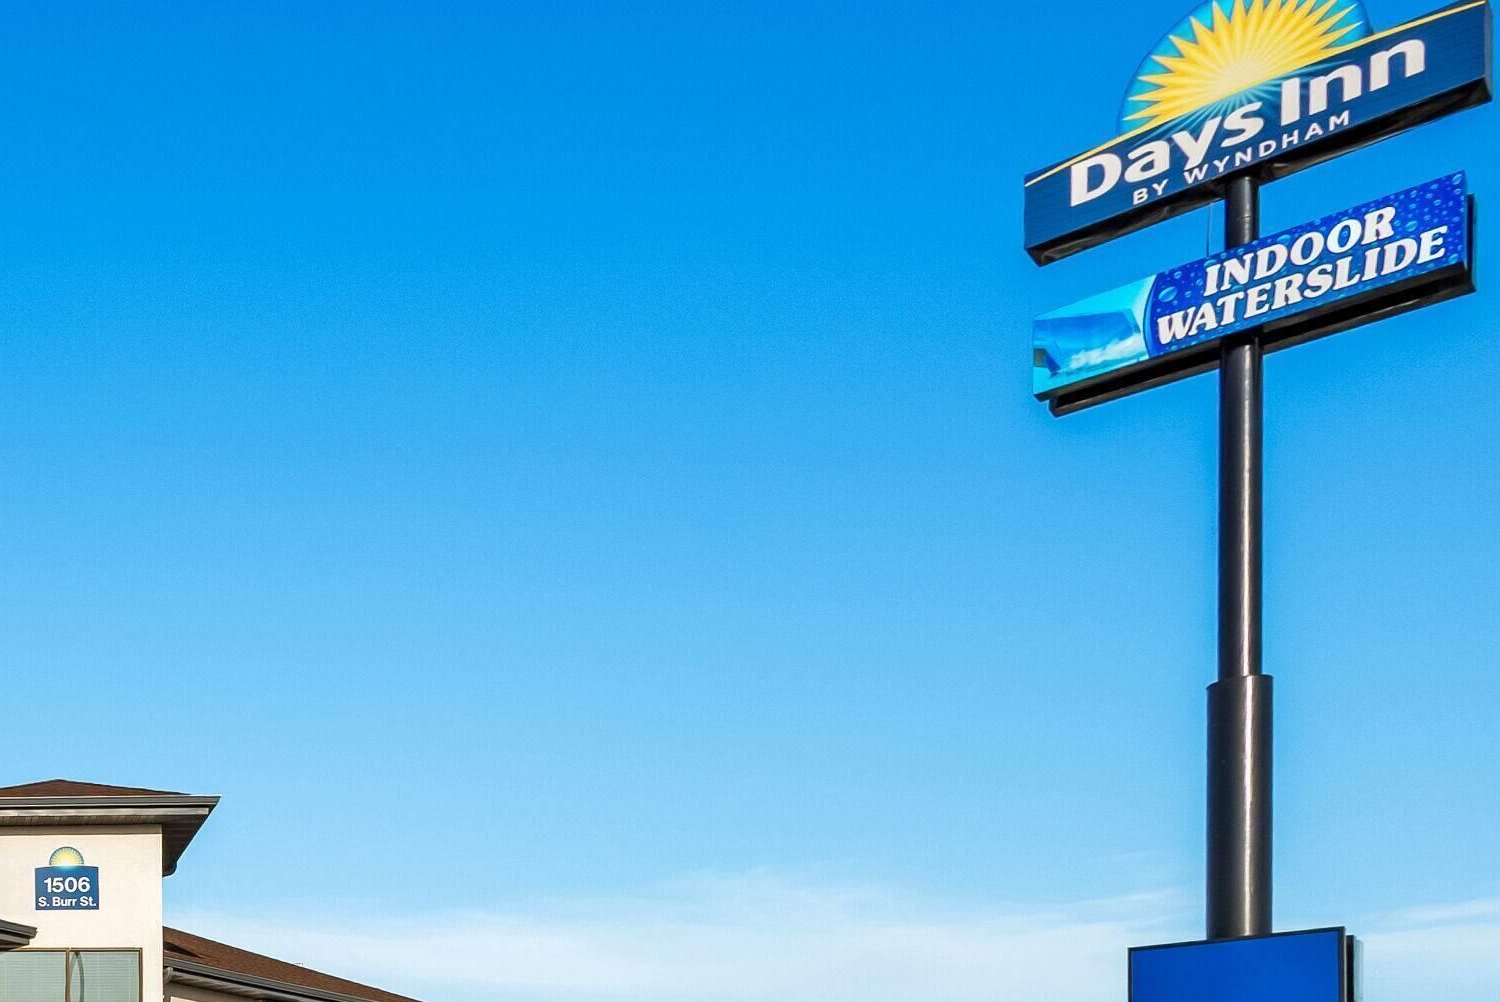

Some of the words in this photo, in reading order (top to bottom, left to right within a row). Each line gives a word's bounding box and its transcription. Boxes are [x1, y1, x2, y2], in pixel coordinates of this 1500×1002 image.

[1070, 101, 1263, 207] Days
[1280, 37, 1426, 122] Inn
[1132, 178, 1170, 206] BY
[1183, 109, 1351, 185] WYNDHAM
[1156, 225, 1449, 346] WATERSLIDE
[1202, 206, 1397, 297] INDOOR
[38, 896, 50, 907] S.
[52, 896, 78, 907] Burr
[80, 895, 97, 907] St.
[43, 876, 91, 893] 1506
